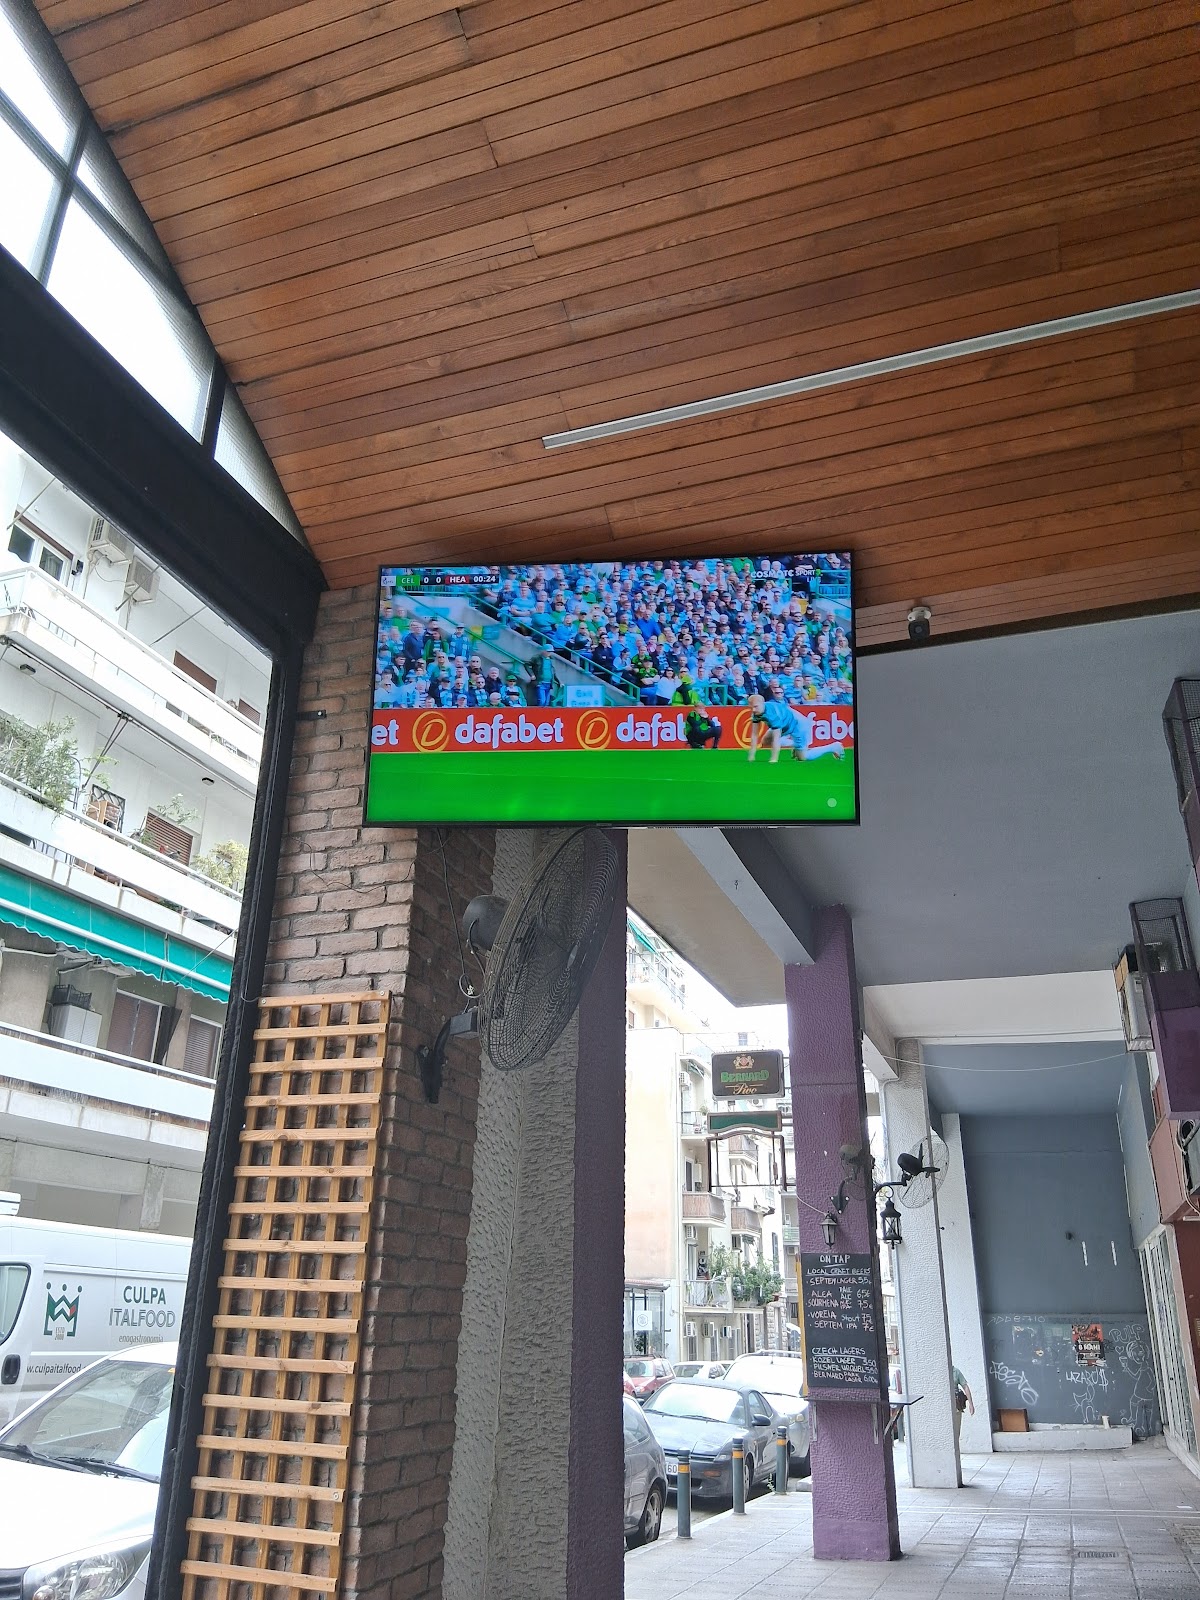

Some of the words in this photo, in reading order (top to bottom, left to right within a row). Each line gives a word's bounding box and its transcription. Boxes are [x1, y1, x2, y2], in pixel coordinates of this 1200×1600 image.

[455, 714, 564, 749] dafabet
[720, 1069, 770, 1083] BERNARD
[733, 1083, 757, 1095] Pivo
[819, 1254, 831, 1264] ON
[832, 1254, 851, 1264] TAP
[830, 1267, 849, 1275] CRAFT
[809, 1277, 836, 1286] SEPTEM
[123, 1285, 166, 1305] CULPA
[108, 1308, 176, 1328] ITALFOOD
[810, 1310, 837, 1319] VOREIA
[814, 1320, 843, 1329] SEPTEM
[811, 1347, 838, 1355] CZECH
[840, 1347, 866, 1355] LAGERS
[812, 1356, 835, 1364] KOZEL
[836, 1356, 856, 1365] LAGER
[26, 1363, 83, 1376] w.culpaitalfood
[814, 1371, 844, 1380] BERNARD
